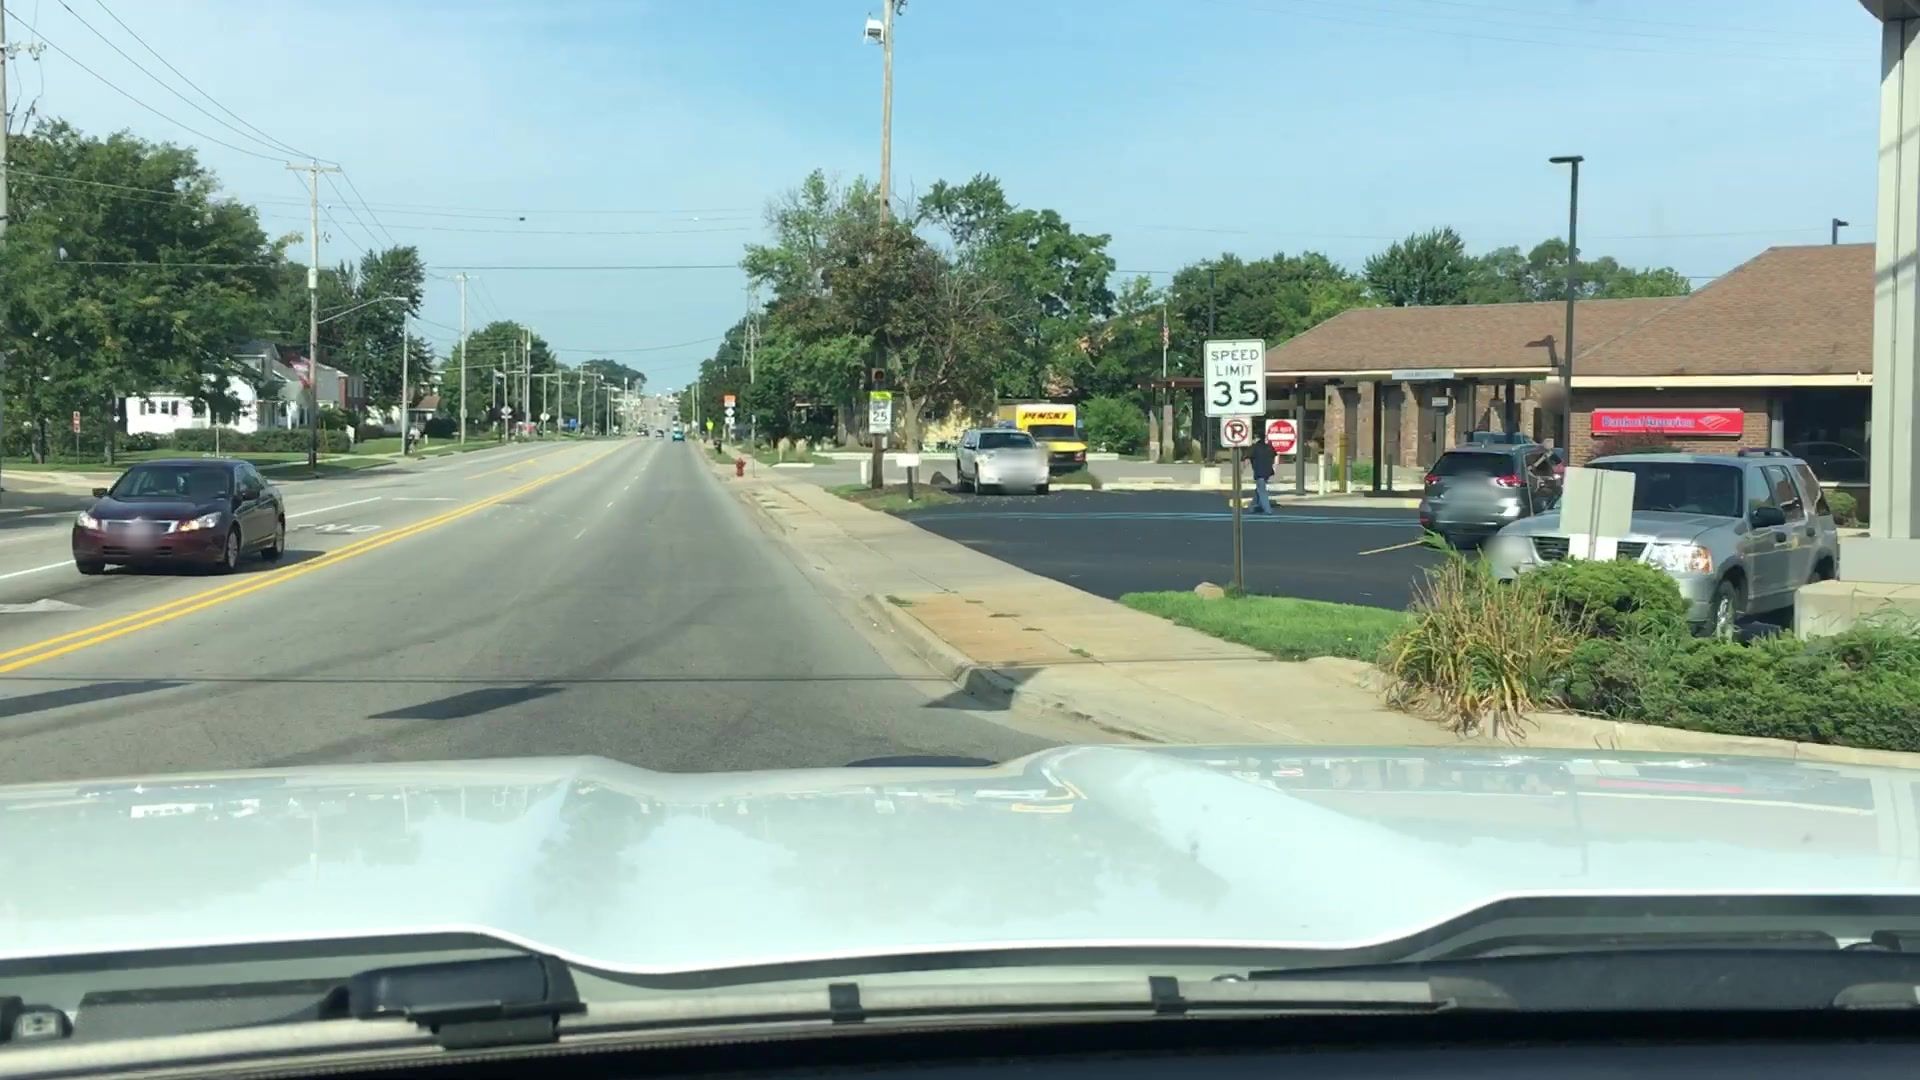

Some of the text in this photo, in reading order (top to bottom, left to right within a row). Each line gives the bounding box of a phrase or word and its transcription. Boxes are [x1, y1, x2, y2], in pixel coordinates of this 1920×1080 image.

[1211, 349, 1259, 361] SPEED
[1215, 364, 1253, 377] LIMIT
[1213, 380, 1259, 407] 35
[873, 411, 888, 422] 25
[1602, 415, 1629, 427] Bank
